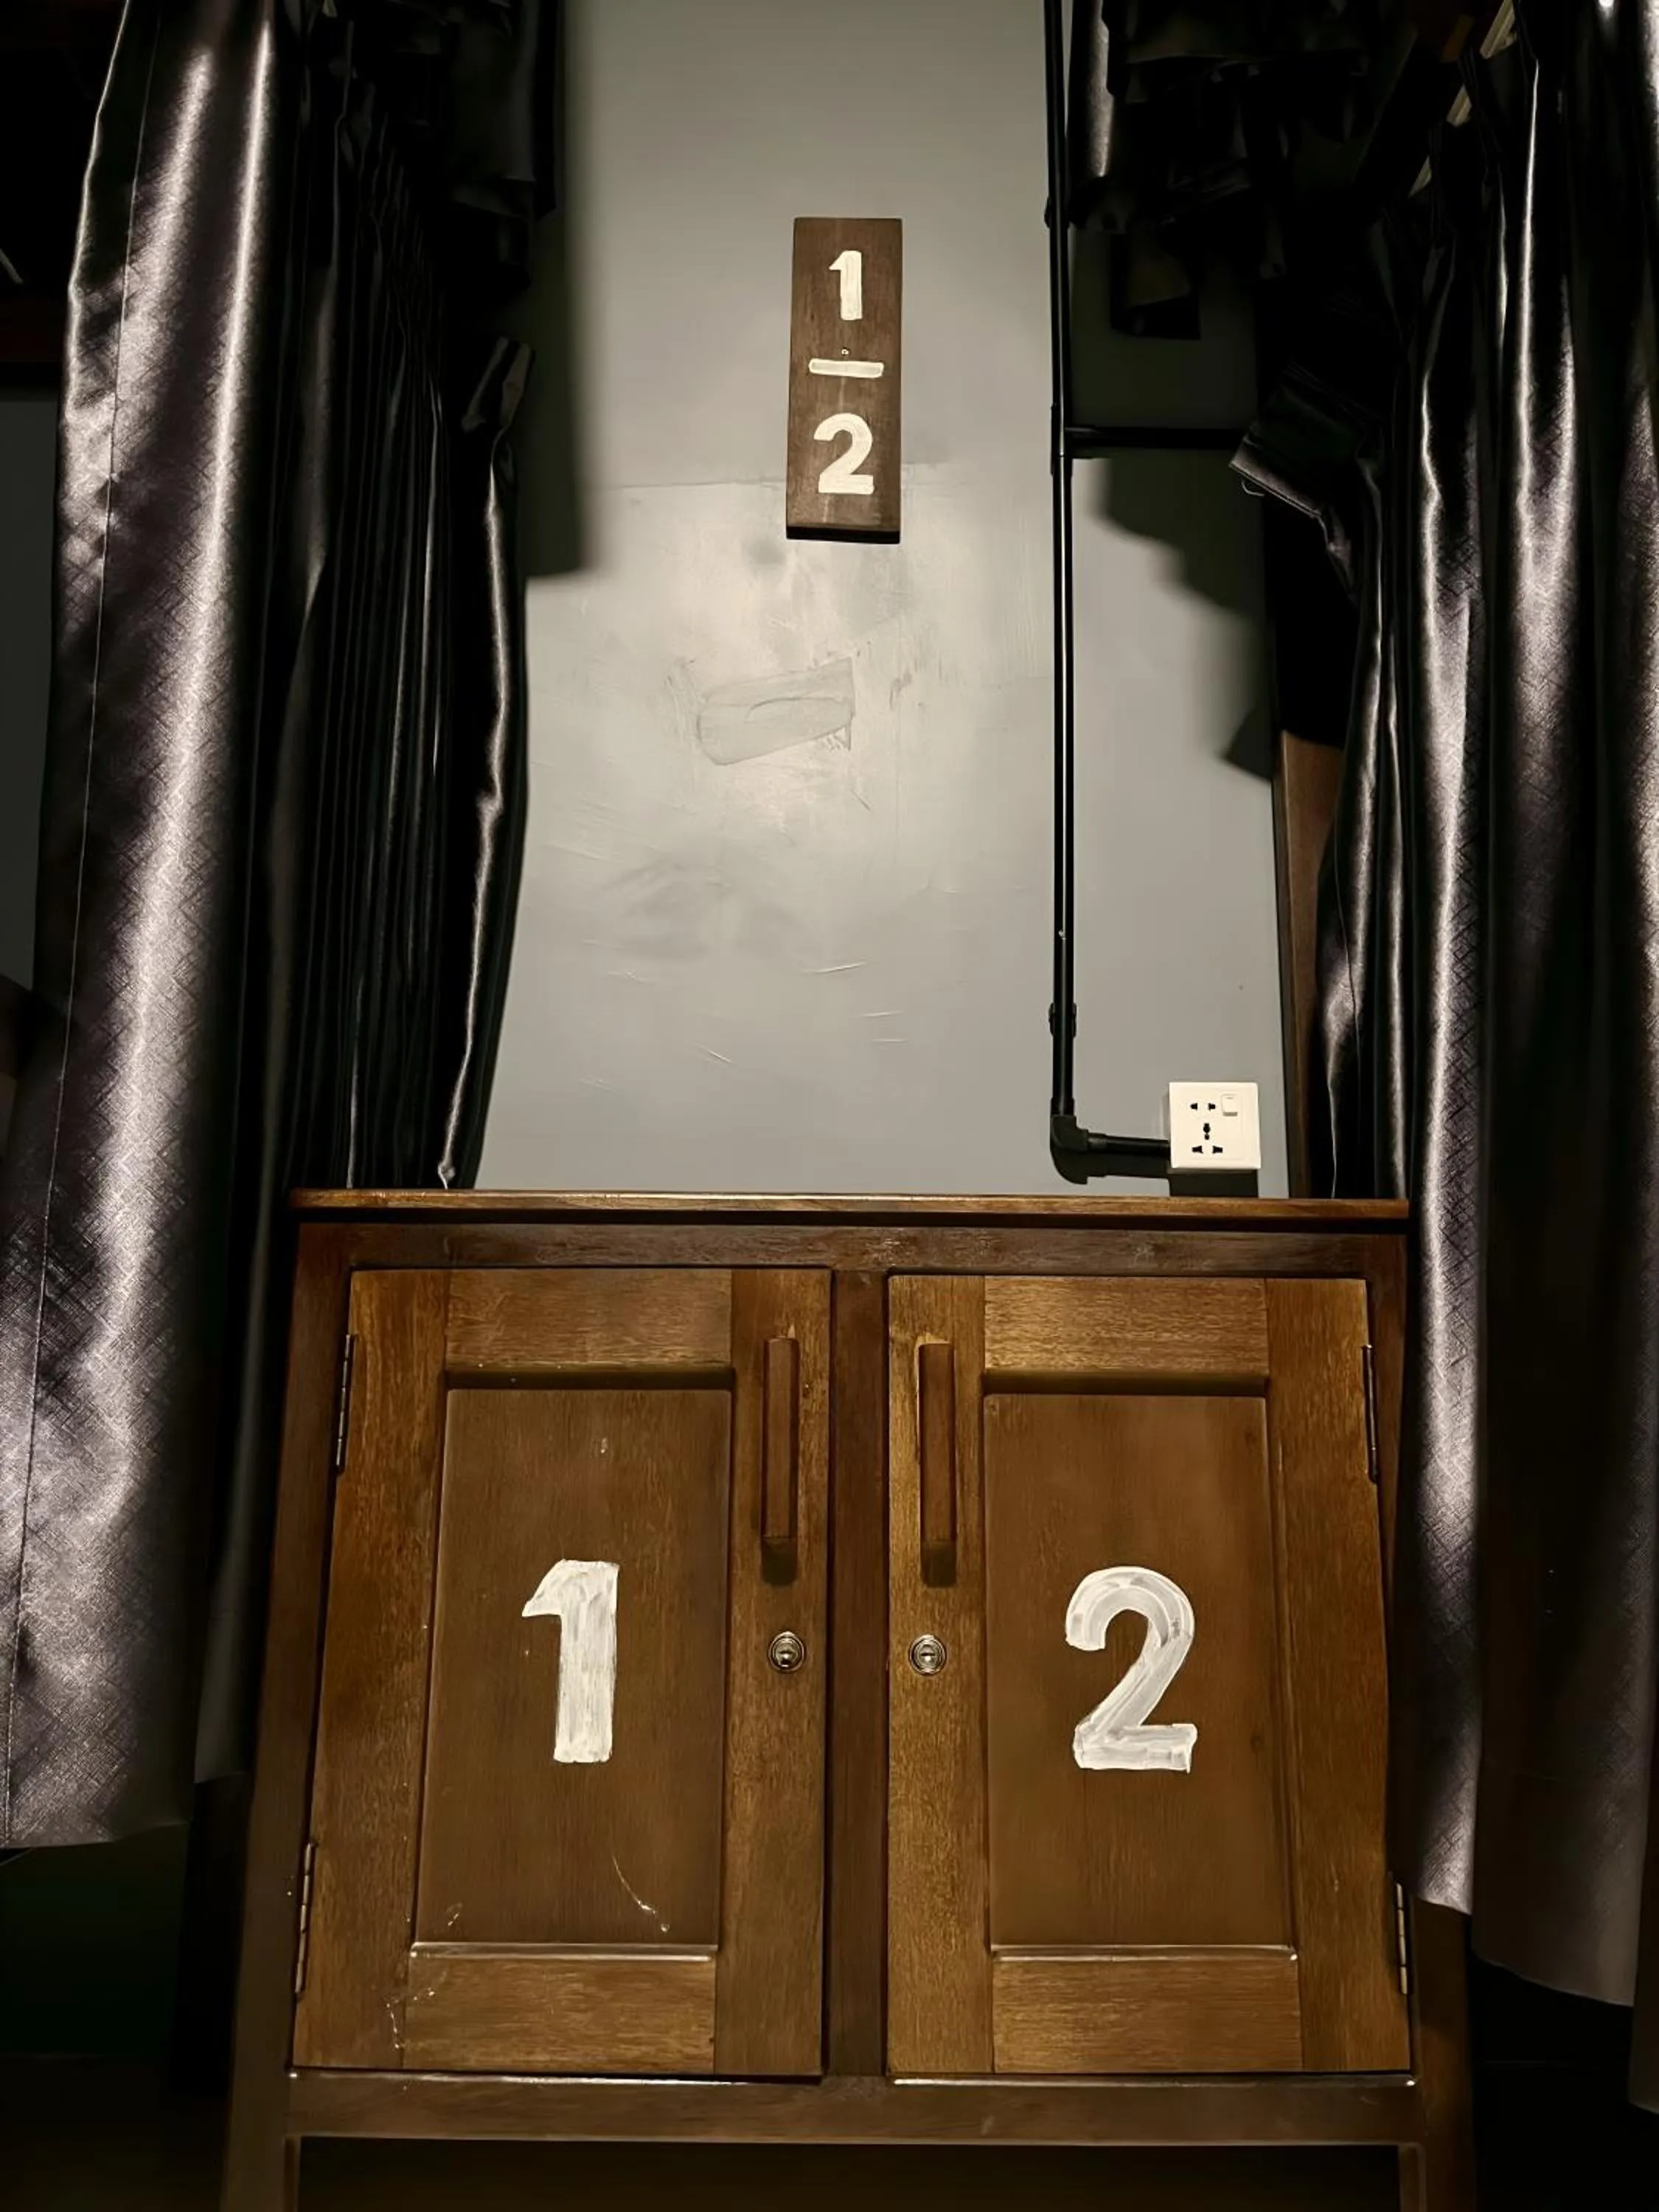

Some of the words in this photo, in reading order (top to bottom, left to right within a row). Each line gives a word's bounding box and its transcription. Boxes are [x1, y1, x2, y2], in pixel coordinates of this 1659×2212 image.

[828, 250, 863, 321] 1
[813, 411, 875, 495] 2
[521, 1558, 620, 1764] 1
[1065, 1565, 1198, 1773] 2
